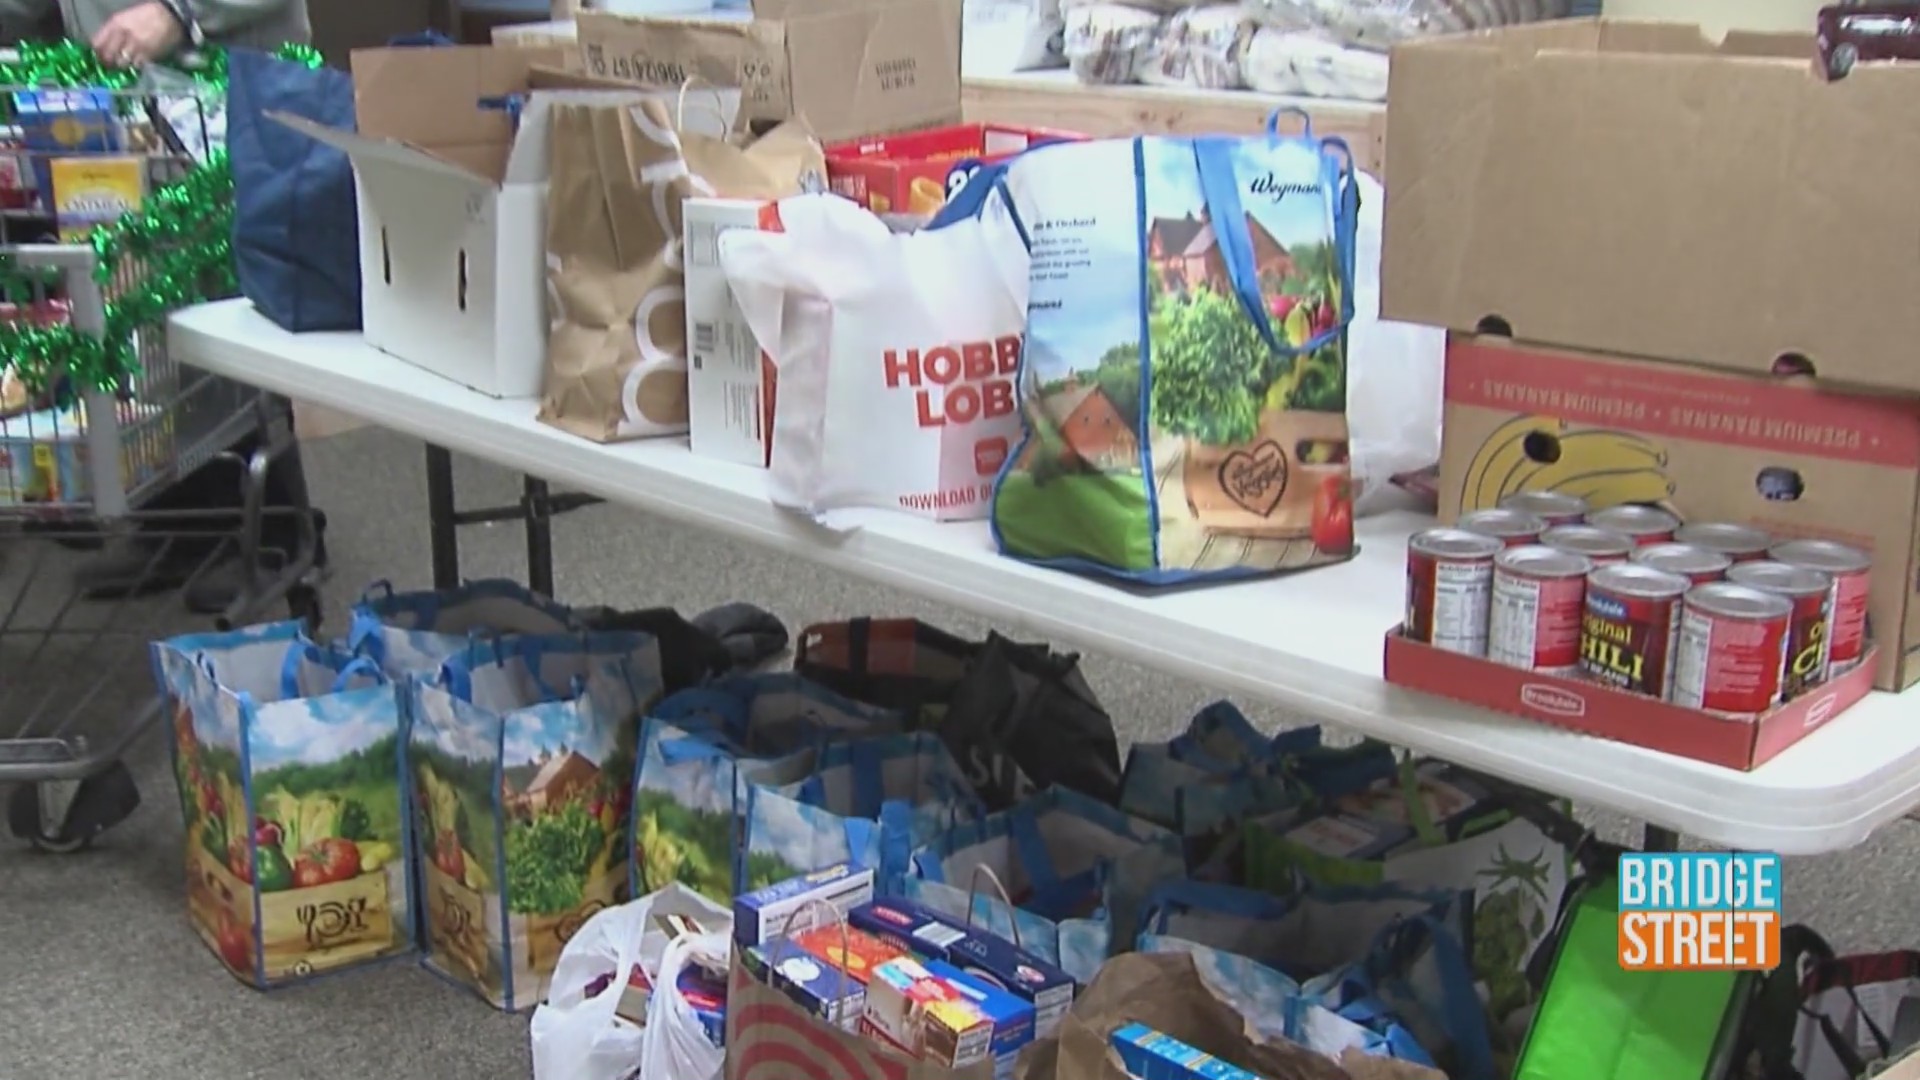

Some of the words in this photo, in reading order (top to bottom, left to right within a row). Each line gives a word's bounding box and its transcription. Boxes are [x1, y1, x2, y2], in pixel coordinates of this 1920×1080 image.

[884, 334, 1022, 388] HOBB
[1482, 379, 1561, 408] BANANAS
[1564, 391, 1648, 420] PREMIUM
[1669, 406, 1761, 438] BANANAS
[1765, 417, 1861, 449] PREMIUM
[899, 486, 976, 510] DOWNLOAD
[1583, 614, 1632, 646] riginal
[1580, 632, 1644, 682] HILI
